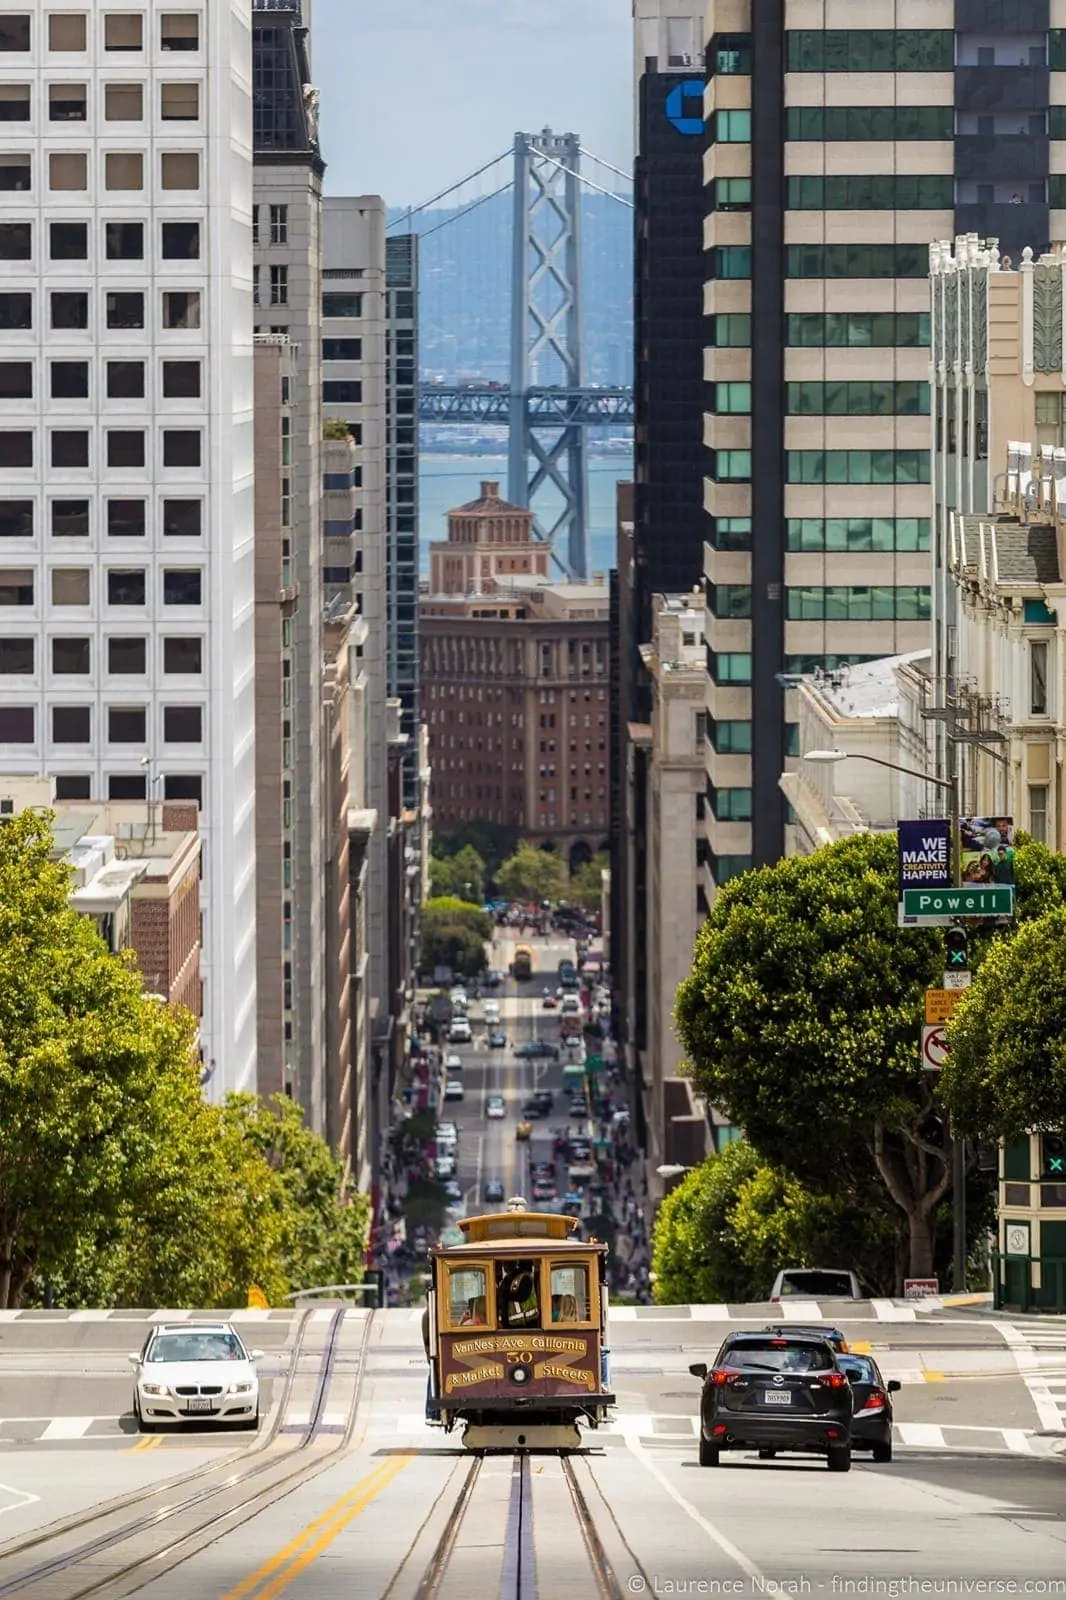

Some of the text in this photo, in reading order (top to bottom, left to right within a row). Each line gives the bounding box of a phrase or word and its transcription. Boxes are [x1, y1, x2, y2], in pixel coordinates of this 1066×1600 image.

[922, 838, 947, 850] WE
[902, 850, 947, 863] MAKE
[903, 863, 946, 871] CREATIVITY
[903, 870, 947, 880] HAPPEN
[919, 895, 996, 909] Powell
[455, 1342, 473, 1353] Van
[474, 1340, 499, 1351] Ness
[531, 1337, 585, 1351] California
[506, 1352, 533, 1364] 50
[461, 1365, 500, 1382] Market
[543, 1365, 589, 1381] Streets
